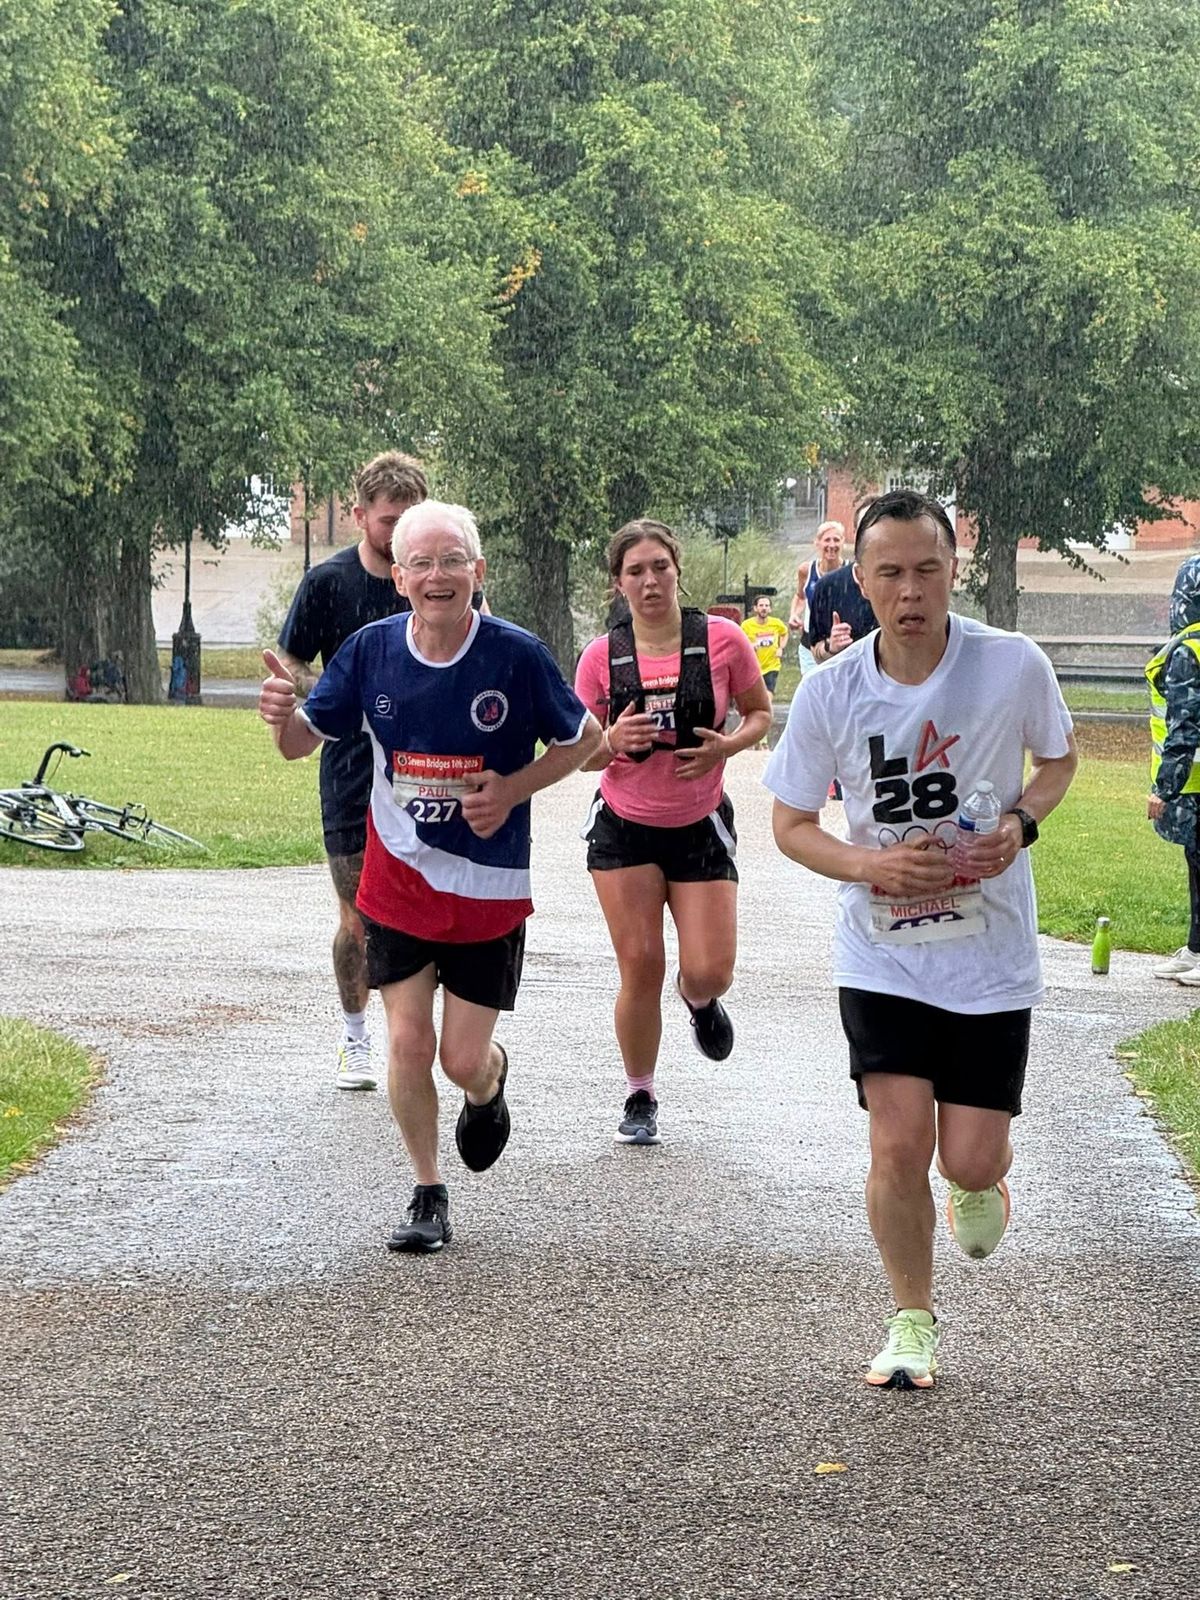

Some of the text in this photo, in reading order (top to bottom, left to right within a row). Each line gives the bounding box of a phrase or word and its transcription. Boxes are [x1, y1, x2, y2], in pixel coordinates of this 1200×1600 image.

[868, 719, 960, 780] LA
[408, 756, 425, 766] Severn
[426, 758, 450, 770] Bridges
[452, 759, 463, 768] 10k
[418, 786, 452, 798] PAUL
[871, 772, 959, 824] 28
[412, 800, 458, 823] 227
[890, 897, 961, 918] MICHAEL
